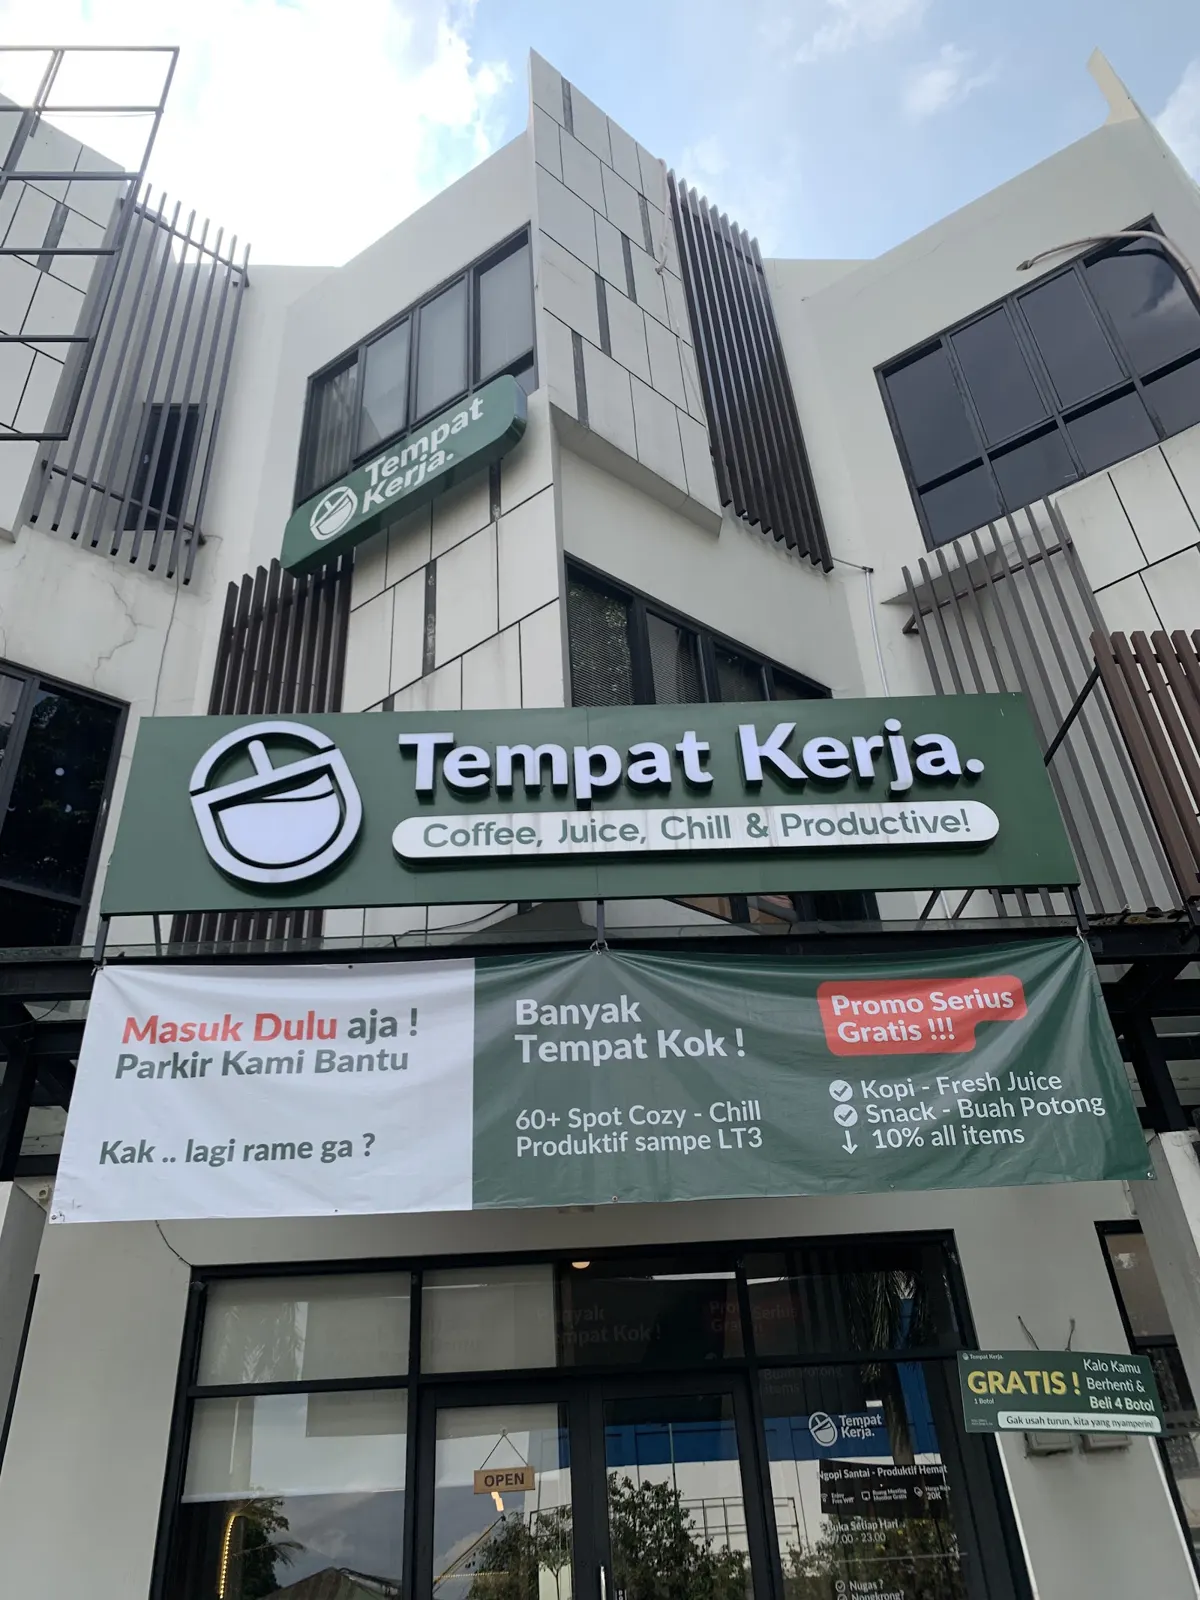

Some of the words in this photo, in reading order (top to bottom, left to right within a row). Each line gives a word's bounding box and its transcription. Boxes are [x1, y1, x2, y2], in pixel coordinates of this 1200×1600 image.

[365, 397, 484, 486] Tempat
[362, 449, 454, 514] Kerja.
[398, 729, 714, 800] Tempat
[737, 718, 985, 791] Kerja.
[422, 822, 543, 848] Coffee,
[558, 818, 647, 845] Juice,
[661, 814, 732, 841] Chill
[746, 812, 769, 839] &
[782, 810, 972, 837] Productive!
[515, 994, 642, 1030] Banyak
[831, 994, 923, 1016] Promo
[929, 988, 1014, 1012] Serius
[122, 1013, 244, 1044] Masuk
[253, 1010, 338, 1042] Dulu
[347, 1008, 398, 1044] aja
[837, 1019, 922, 1043] Gratis
[928, 1017, 956, 1041] !!!
[514, 1033, 648, 1066] Tempat
[657, 1029, 728, 1058] Kok
[115, 1051, 213, 1080] Parkir
[221, 1049, 305, 1076] Kami
[314, 1048, 409, 1074] Bantu
[861, 1078, 915, 1102] Kopi
[936, 1071, 1001, 1096] Fresh
[1007, 1071, 1063, 1092] Juice
[516, 1109, 561, 1130] 60+
[568, 1106, 622, 1132] Spot
[628, 1105, 686, 1128] Cozy
[709, 1100, 762, 1123] Chill
[866, 1100, 937, 1124] Snack
[958, 1098, 1015, 1120] Buah
[1022, 1096, 1106, 1118] Potong
[99, 1139, 156, 1165] Kak
[185, 1138, 235, 1167] lagi
[242, 1140, 314, 1162] rame
[320, 1139, 353, 1163] ga
[362, 1133, 376, 1157] ?
[516, 1131, 628, 1157] Produktif
[635, 1133, 711, 1155] sampe
[718, 1127, 763, 1149] LT3
[872, 1126, 925, 1149] 10%
[931, 1124, 956, 1147] all
[962, 1125, 1025, 1146] items
[1083, 1359, 1108, 1372] Kalo
[1111, 1360, 1141, 1374] Kamu
[967, 1370, 1068, 1395] GRATIS
[1086, 1377, 1133, 1392] Berhenti
[1136, 1380, 1145, 1393] &
[1089, 1396, 1112, 1409] Beli
[1114, 1397, 1123, 1409] 4
[1125, 1398, 1155, 1412] Botol
[839, 1414, 882, 1427] Tempat
[841, 1426, 875, 1440] Kerja.
[1006, 1415, 1024, 1425] Gak
[1026, 1416, 1045, 1426] usah
[1047, 1418, 1072, 1427] turun,
[1073, 1417, 1089, 1426] kita
[1091, 1420, 1111, 1428] yang
[1112, 1420, 1154, 1430] nyamperin!
[484, 1473, 525, 1487] OPEN
[844, 1468, 870, 1478] Santai
[877, 1465, 917, 1477] Produktif
[919, 1464, 948, 1474] Hemat
[861, 1532, 886, 1543] 23.00
[849, 1580, 877, 1592] Nugas
